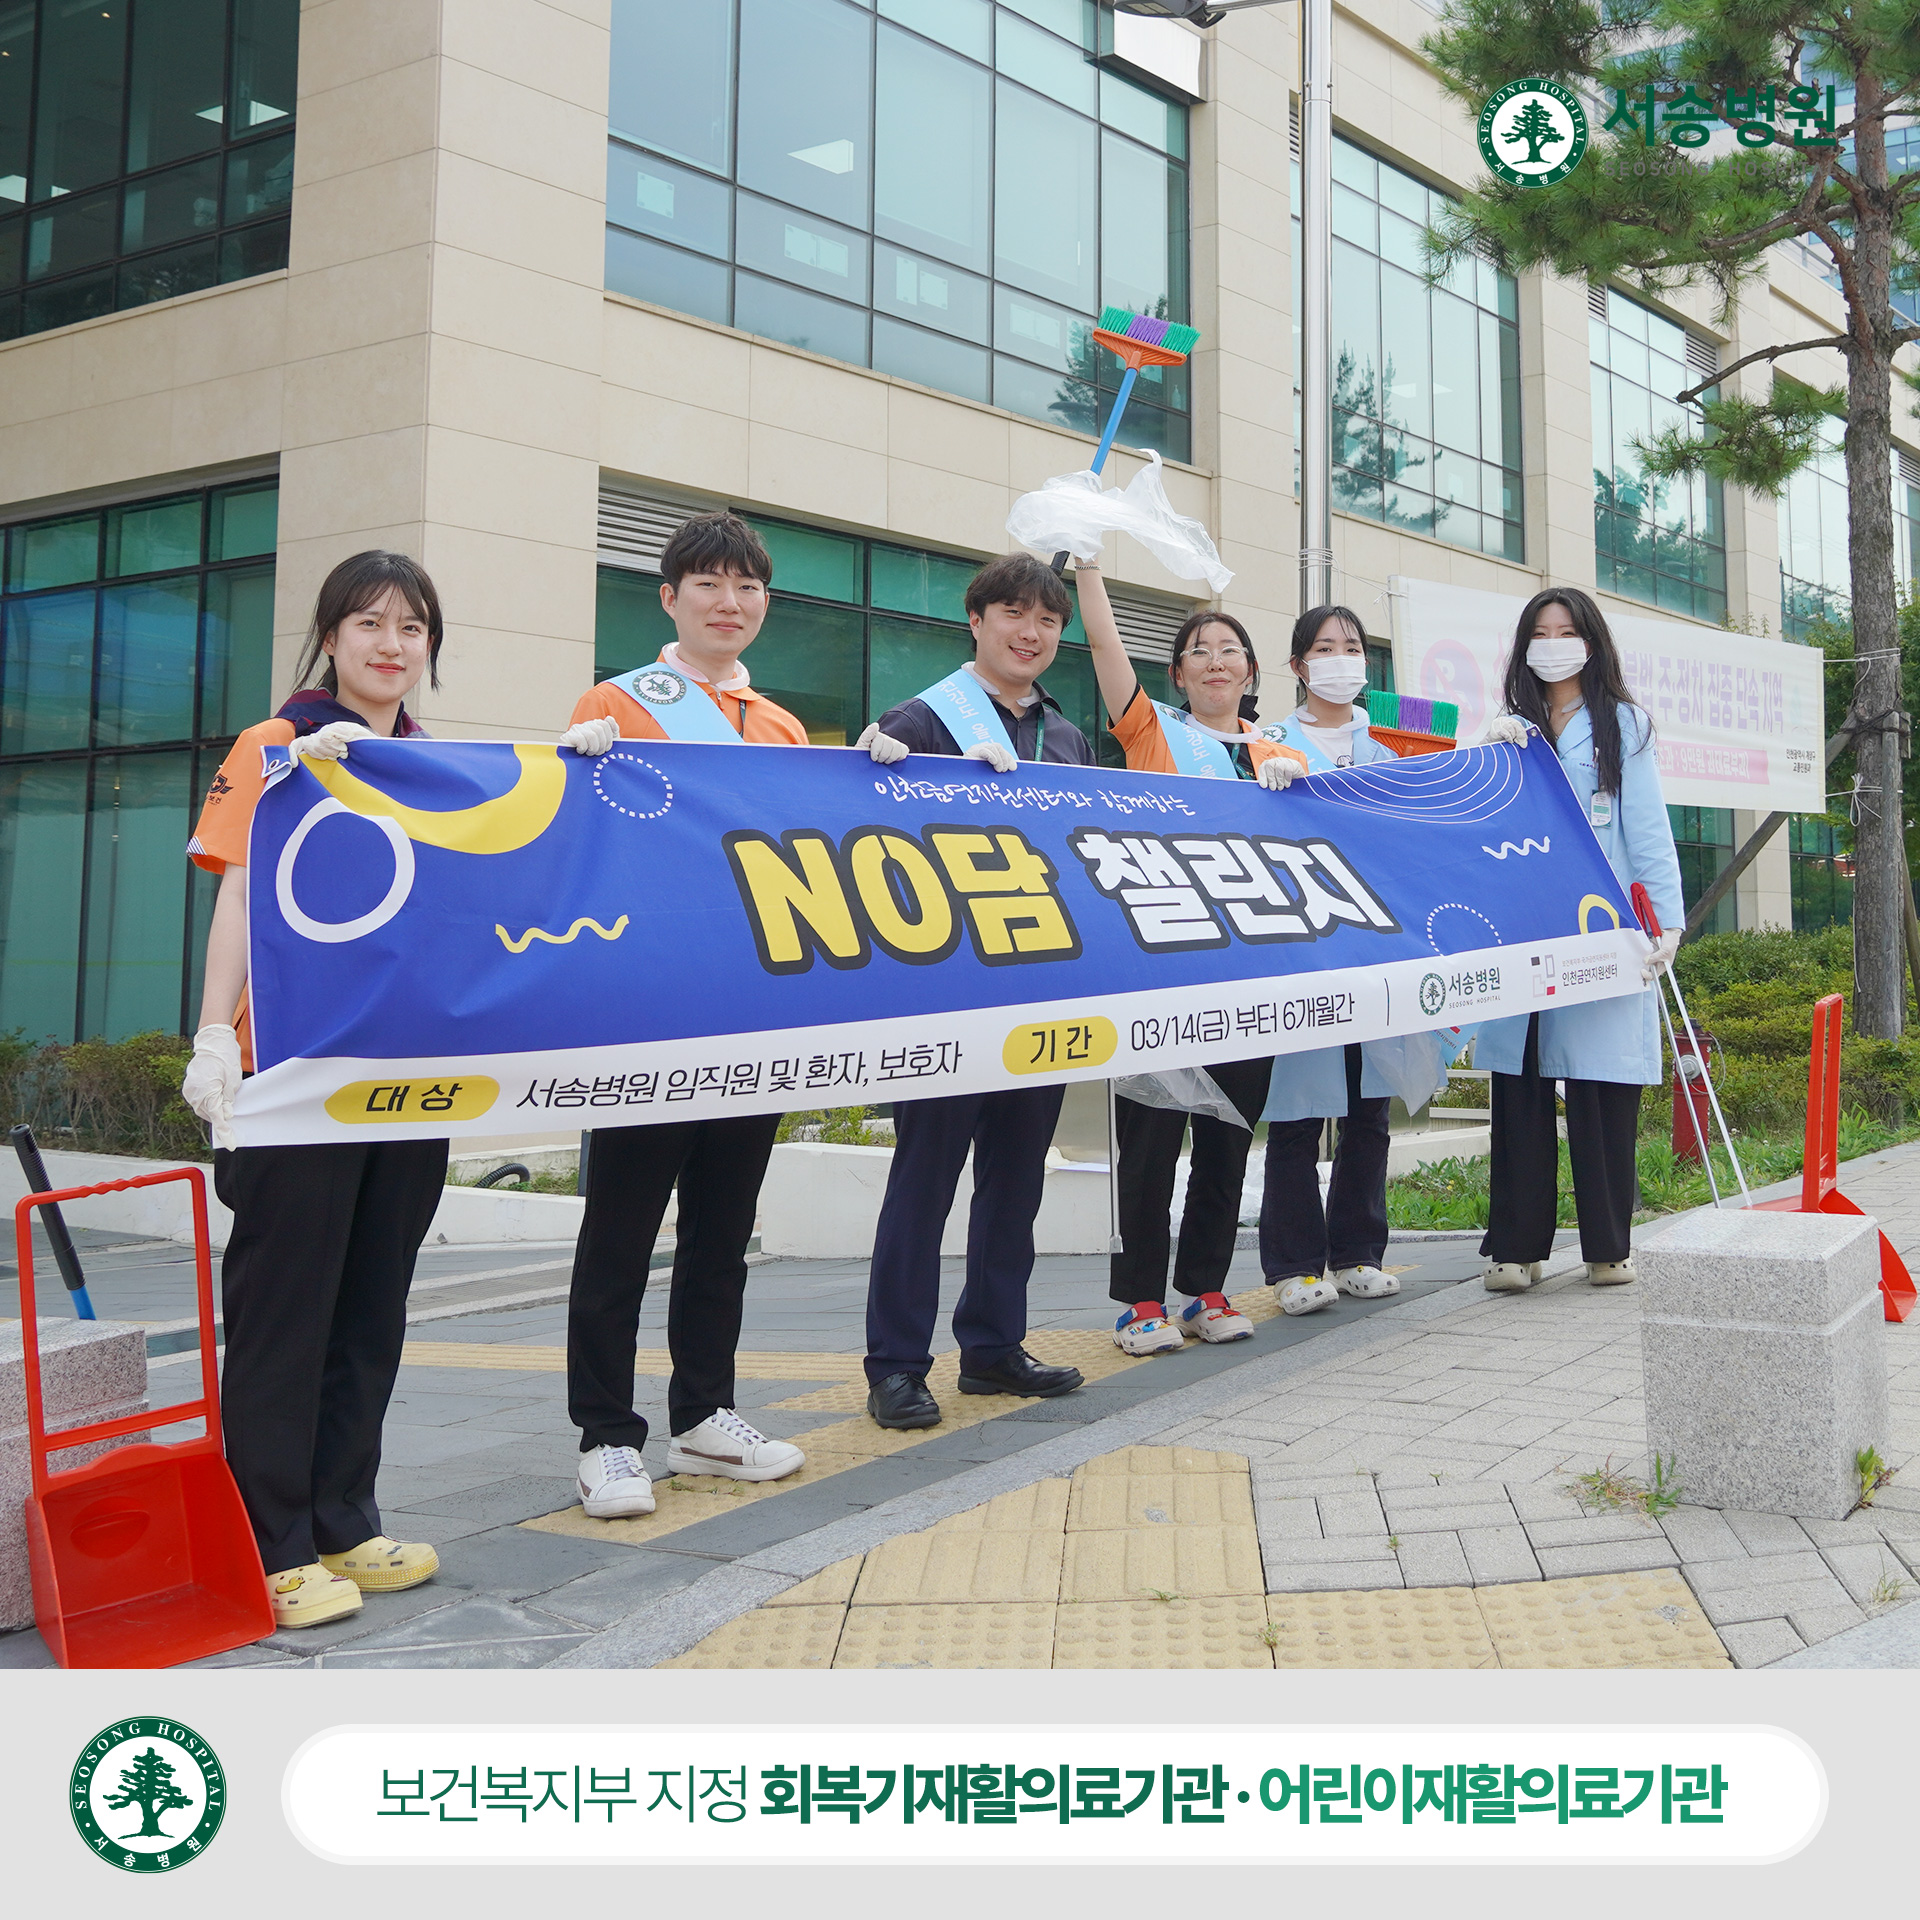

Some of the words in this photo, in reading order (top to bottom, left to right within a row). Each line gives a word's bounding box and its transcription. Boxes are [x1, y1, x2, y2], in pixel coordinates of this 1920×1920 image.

[1707, 663, 1733, 728] 집중
[1736, 668, 1760, 732] 단속
[1762, 672, 1784, 734] 지역
[874, 775, 1093, 812] 인천금연지원센터와
[1096, 789, 1197, 816] 함께하는
[731, 830, 1076, 965] NO담
[1073, 830, 1398, 946] 챌린지
[1448, 966, 1501, 997] 서송병원
[1562, 964, 1618, 987] 인천금연지원센터
[1130, 1014, 1230, 1052] 03/14(금)
[1236, 1006, 1279, 1044] 부터
[1283, 996, 1355, 1031] 6개월간
[515, 1070, 662, 1109] 서송병원
[666, 1061, 764, 1103] 임직원
[769, 1057, 801, 1095] 및
[804, 1052, 870, 1089] 환자,
[876, 1039, 963, 1083] 보호자
